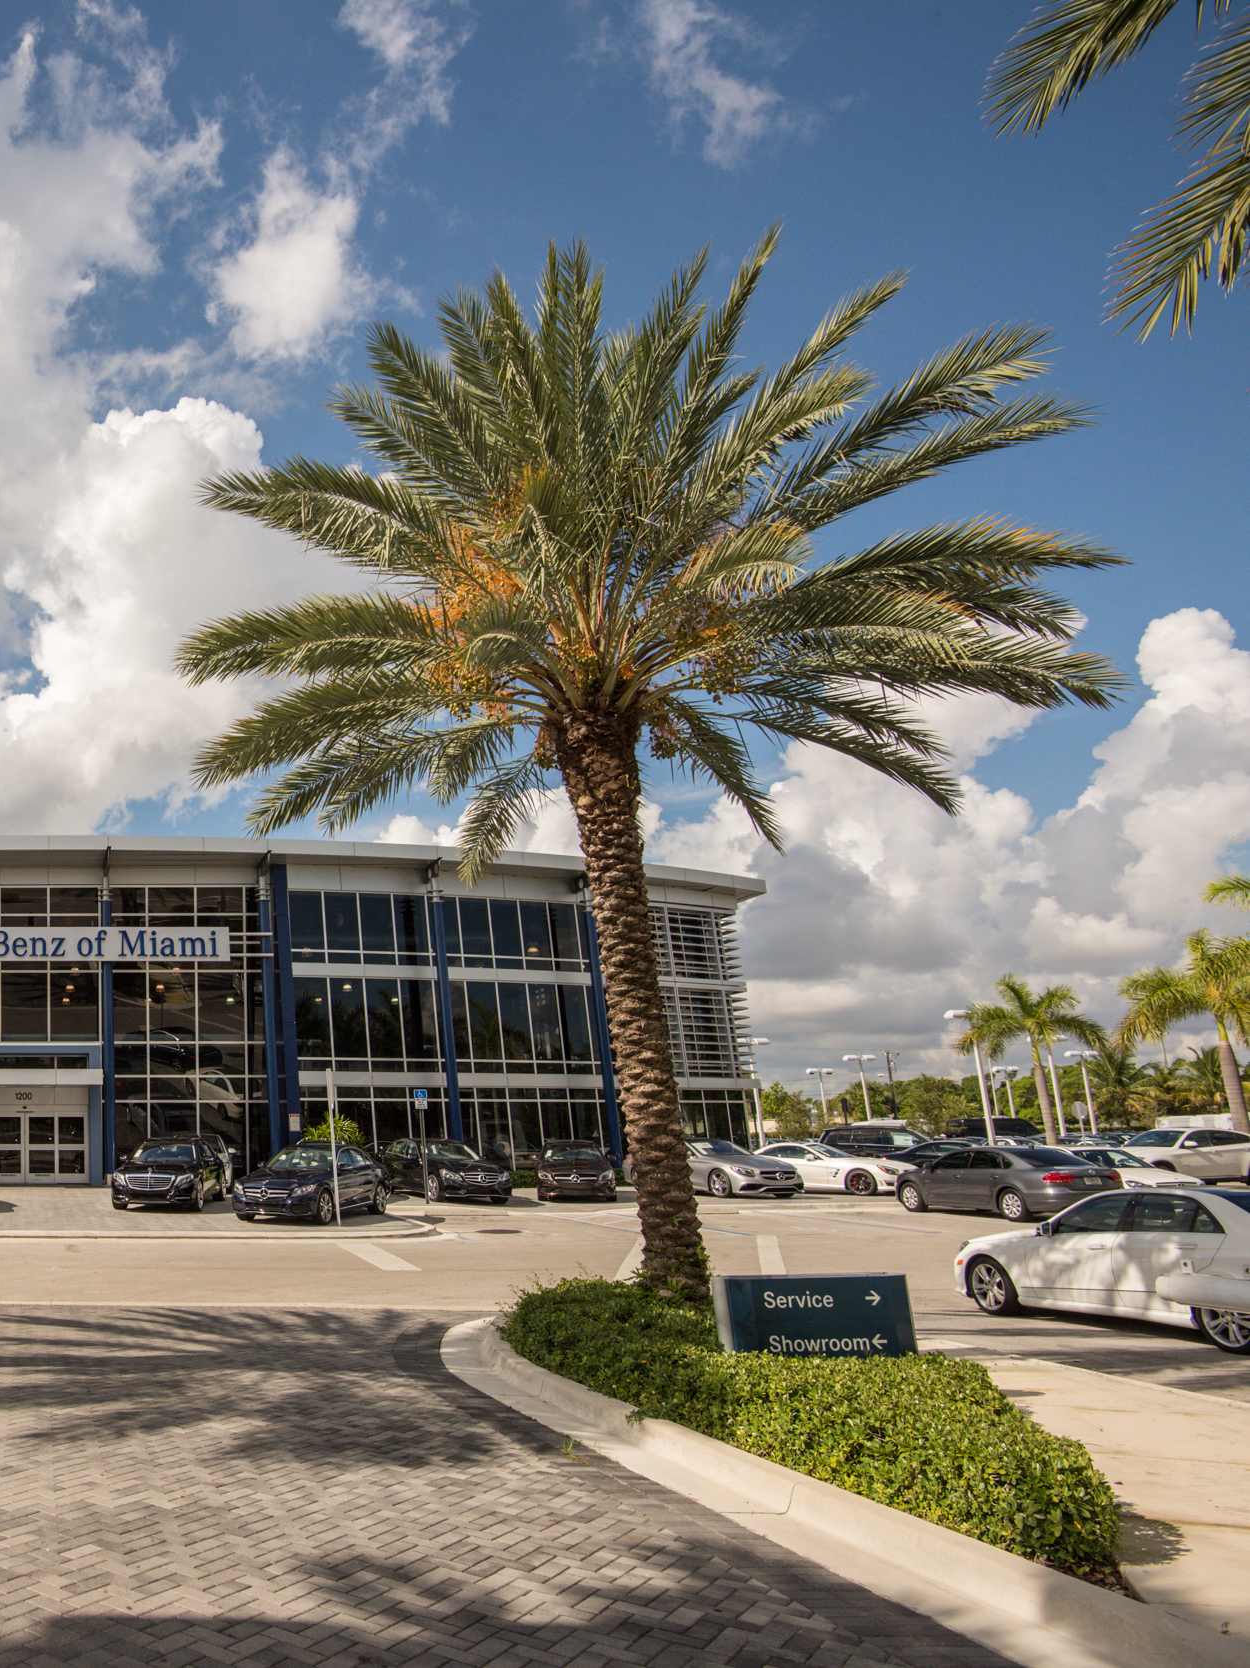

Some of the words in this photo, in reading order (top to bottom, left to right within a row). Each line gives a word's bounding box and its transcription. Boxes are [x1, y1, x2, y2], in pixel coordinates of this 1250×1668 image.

[77, 929, 108, 958] of
[118, 930, 219, 958] Miami
[15, 1092, 33, 1101] 1200
[763, 1291, 834, 1309] Service
[769, 1334, 871, 1353] Showroom
